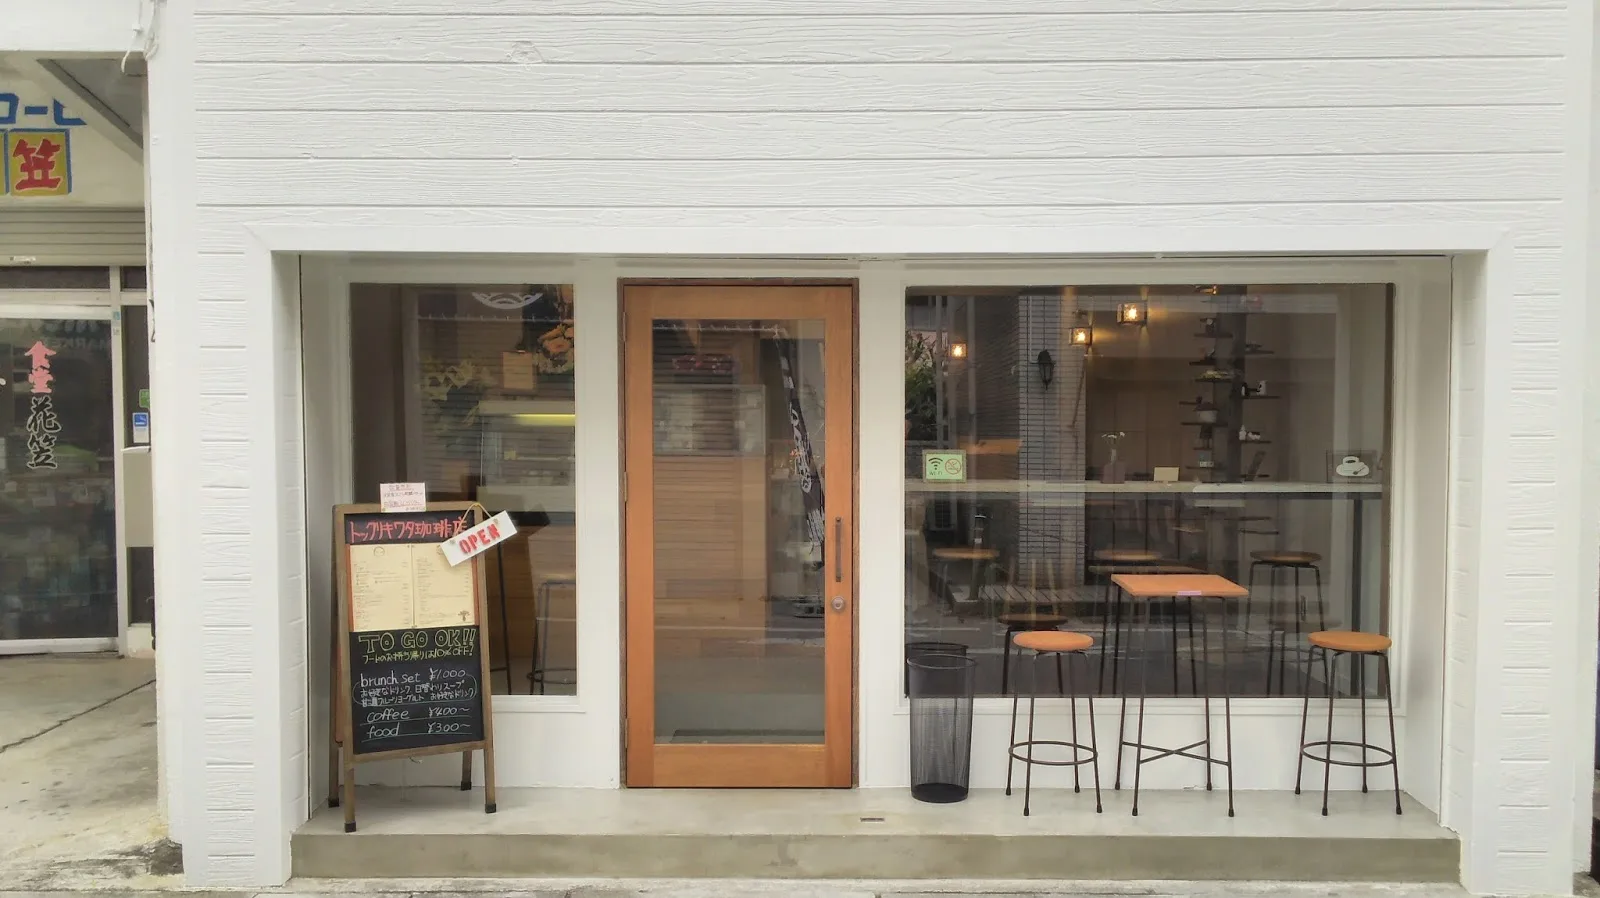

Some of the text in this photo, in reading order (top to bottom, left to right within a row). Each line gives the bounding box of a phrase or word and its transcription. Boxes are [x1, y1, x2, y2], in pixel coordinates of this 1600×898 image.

[12, 137, 62, 192] 笠
[458, 523, 501, 555] OPEN
[358, 628, 477, 654] TO GO OK!!
[360, 670, 399, 688] brunch
[401, 672, 421, 683] set
[366, 708, 411, 723] coffee
[366, 722, 400, 739] food
